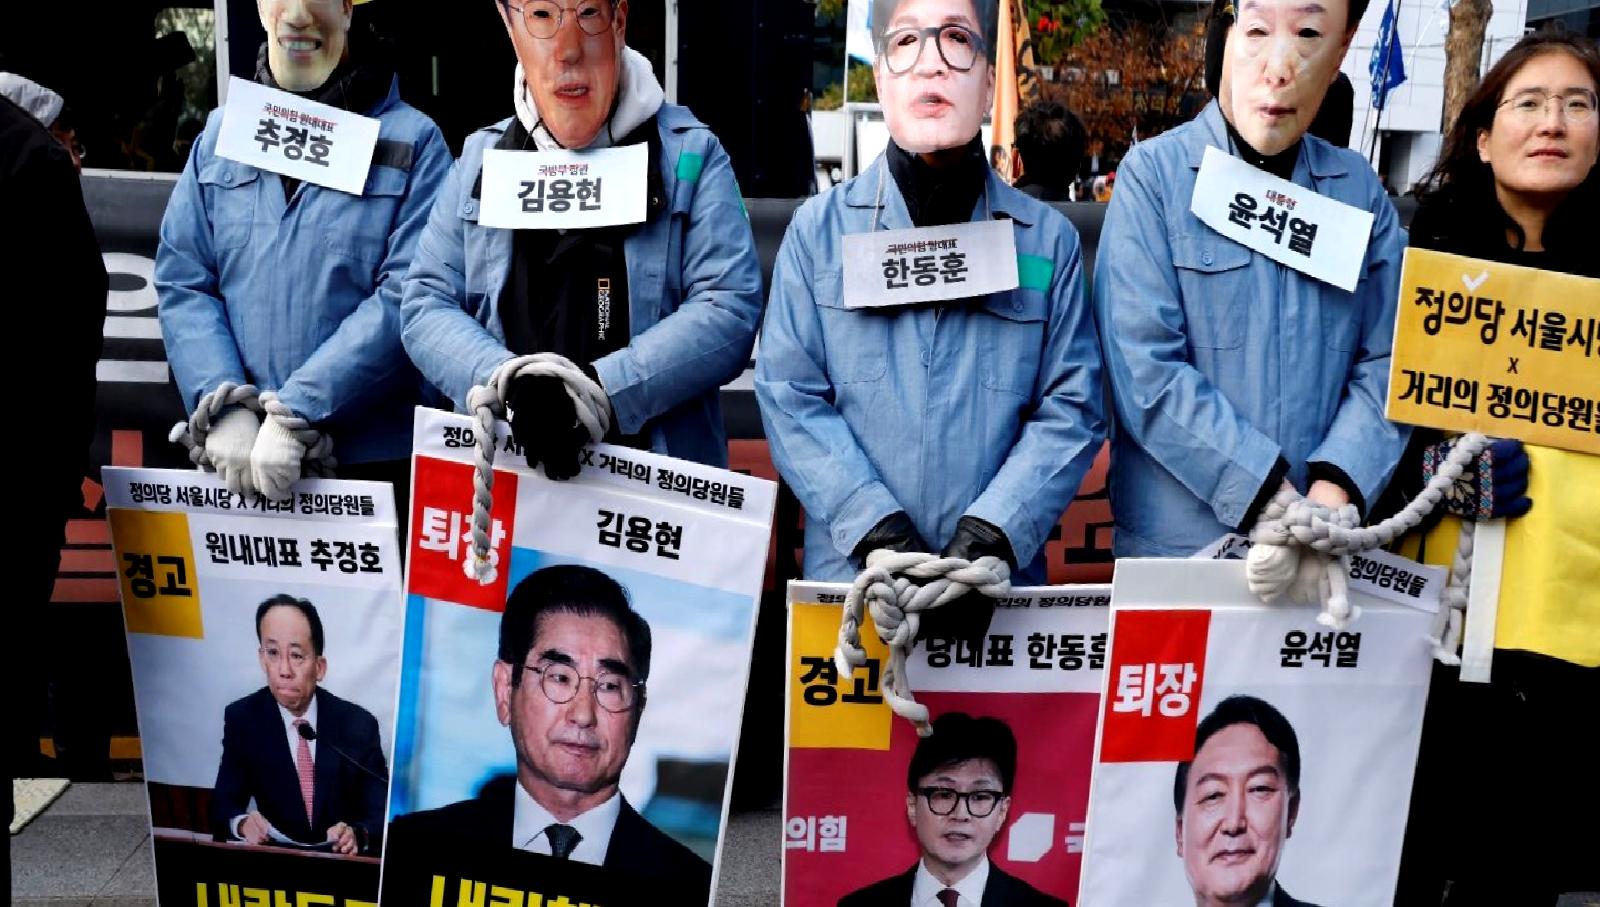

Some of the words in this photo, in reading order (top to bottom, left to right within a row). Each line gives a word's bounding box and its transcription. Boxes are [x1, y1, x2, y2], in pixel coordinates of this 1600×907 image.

[254, 118, 334, 168] 추경호
[517, 177, 602, 213] 김용현
[1228, 191, 1318, 258] 윤석열
[881, 252, 968, 290] 한동훈
[1415, 286, 1505, 345] 정의당
[1510, 308, 1600, 358] 서울시
[1398, 369, 1479, 414] 거리의
[129, 482, 171, 504] 정의당
[176, 486, 231, 509] 서울시당
[299, 493, 375, 516] 정의당원들
[599, 453, 651, 485] 거리의
[657, 468, 746, 511] 정의당원들
[205, 531, 302, 568] 원내대표
[310, 538, 384, 574] 추경호
[597, 509, 683, 560] 김용현
[123, 552, 192, 599] 경고
[1349, 554, 1428, 599] 정의당원들
[926, 634, 1013, 668] 당대표
[1280, 629, 1361, 668] 윤석열
[800, 655, 883, 706] 경고
[1113, 662, 1198, 717] 퇴장
